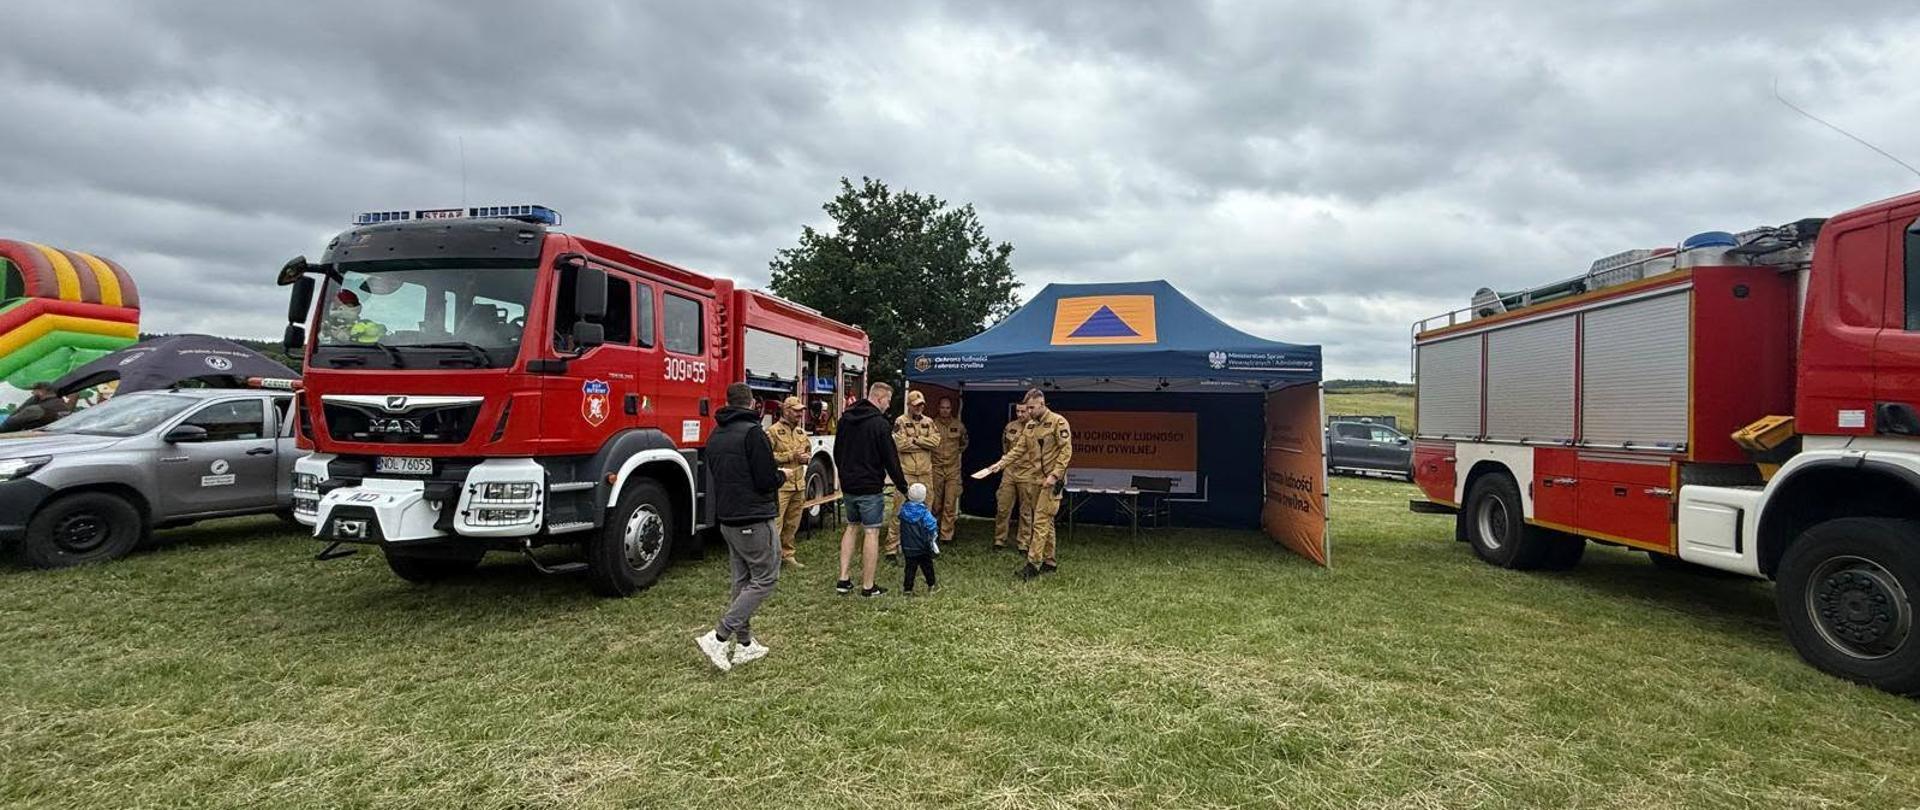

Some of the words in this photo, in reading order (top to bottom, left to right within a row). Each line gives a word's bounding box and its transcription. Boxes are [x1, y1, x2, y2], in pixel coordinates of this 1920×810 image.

[369, 419, 421, 433] MAN
[1084, 431, 1131, 441] OCHRONY
[1133, 430, 1184, 442] LUDNOŚCI
[1106, 444, 1157, 455] CYWILNEJ
[381, 457, 399, 470] NOL
[401, 458, 432, 471] 76055
